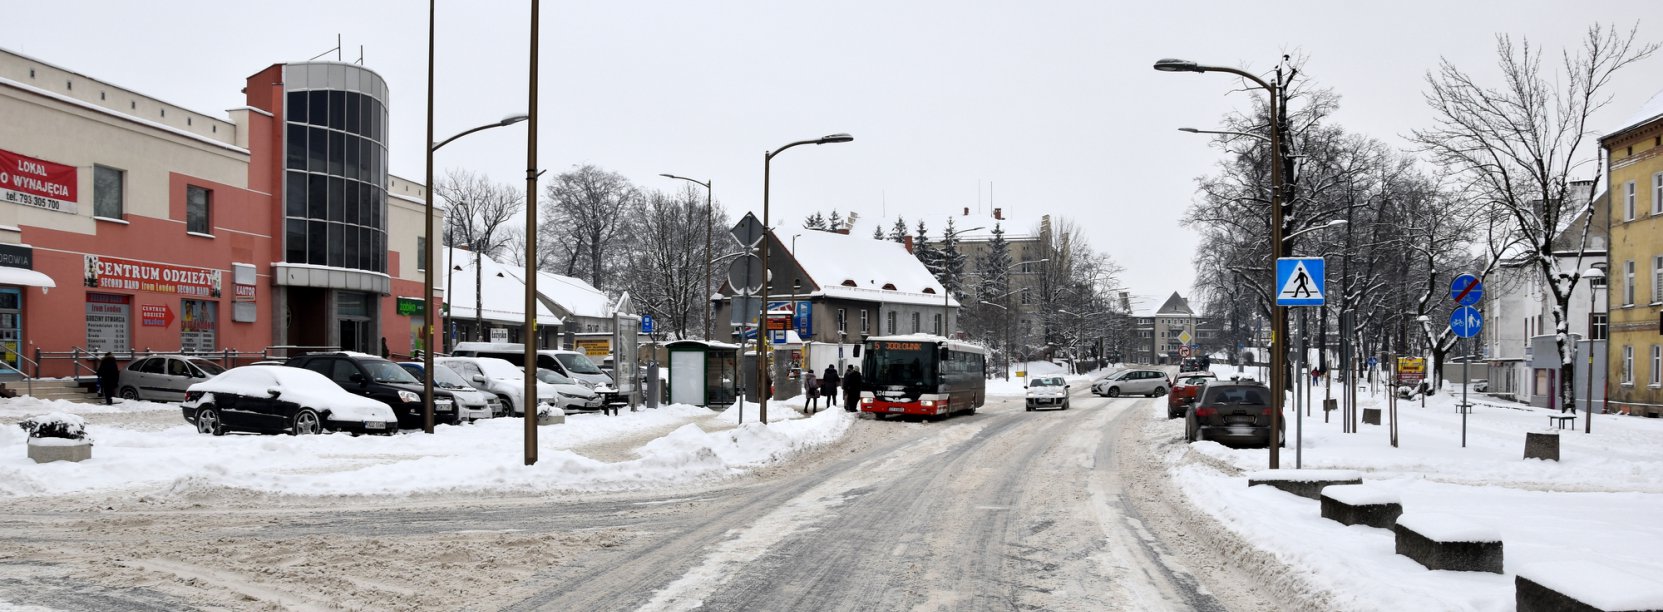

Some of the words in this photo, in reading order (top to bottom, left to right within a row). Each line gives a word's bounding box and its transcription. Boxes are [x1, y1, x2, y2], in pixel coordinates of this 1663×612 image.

[18, 160, 47, 176] LOKAL
[13, 175, 69, 197] WYNAJĘCIA
[6, 192, 18, 201] tel.
[20, 194, 32, 204] 793
[34, 196, 46, 208] 305
[48, 199, 60, 210] 700
[96, 262, 160, 280] CENTRUM
[163, 269, 213, 286] ODZIEŻY
[100, 278, 123, 288] SECOND
[124, 280, 139, 290] HAND
[177, 286, 195, 294] SECOND
[236, 286, 256, 296] KANTOR
